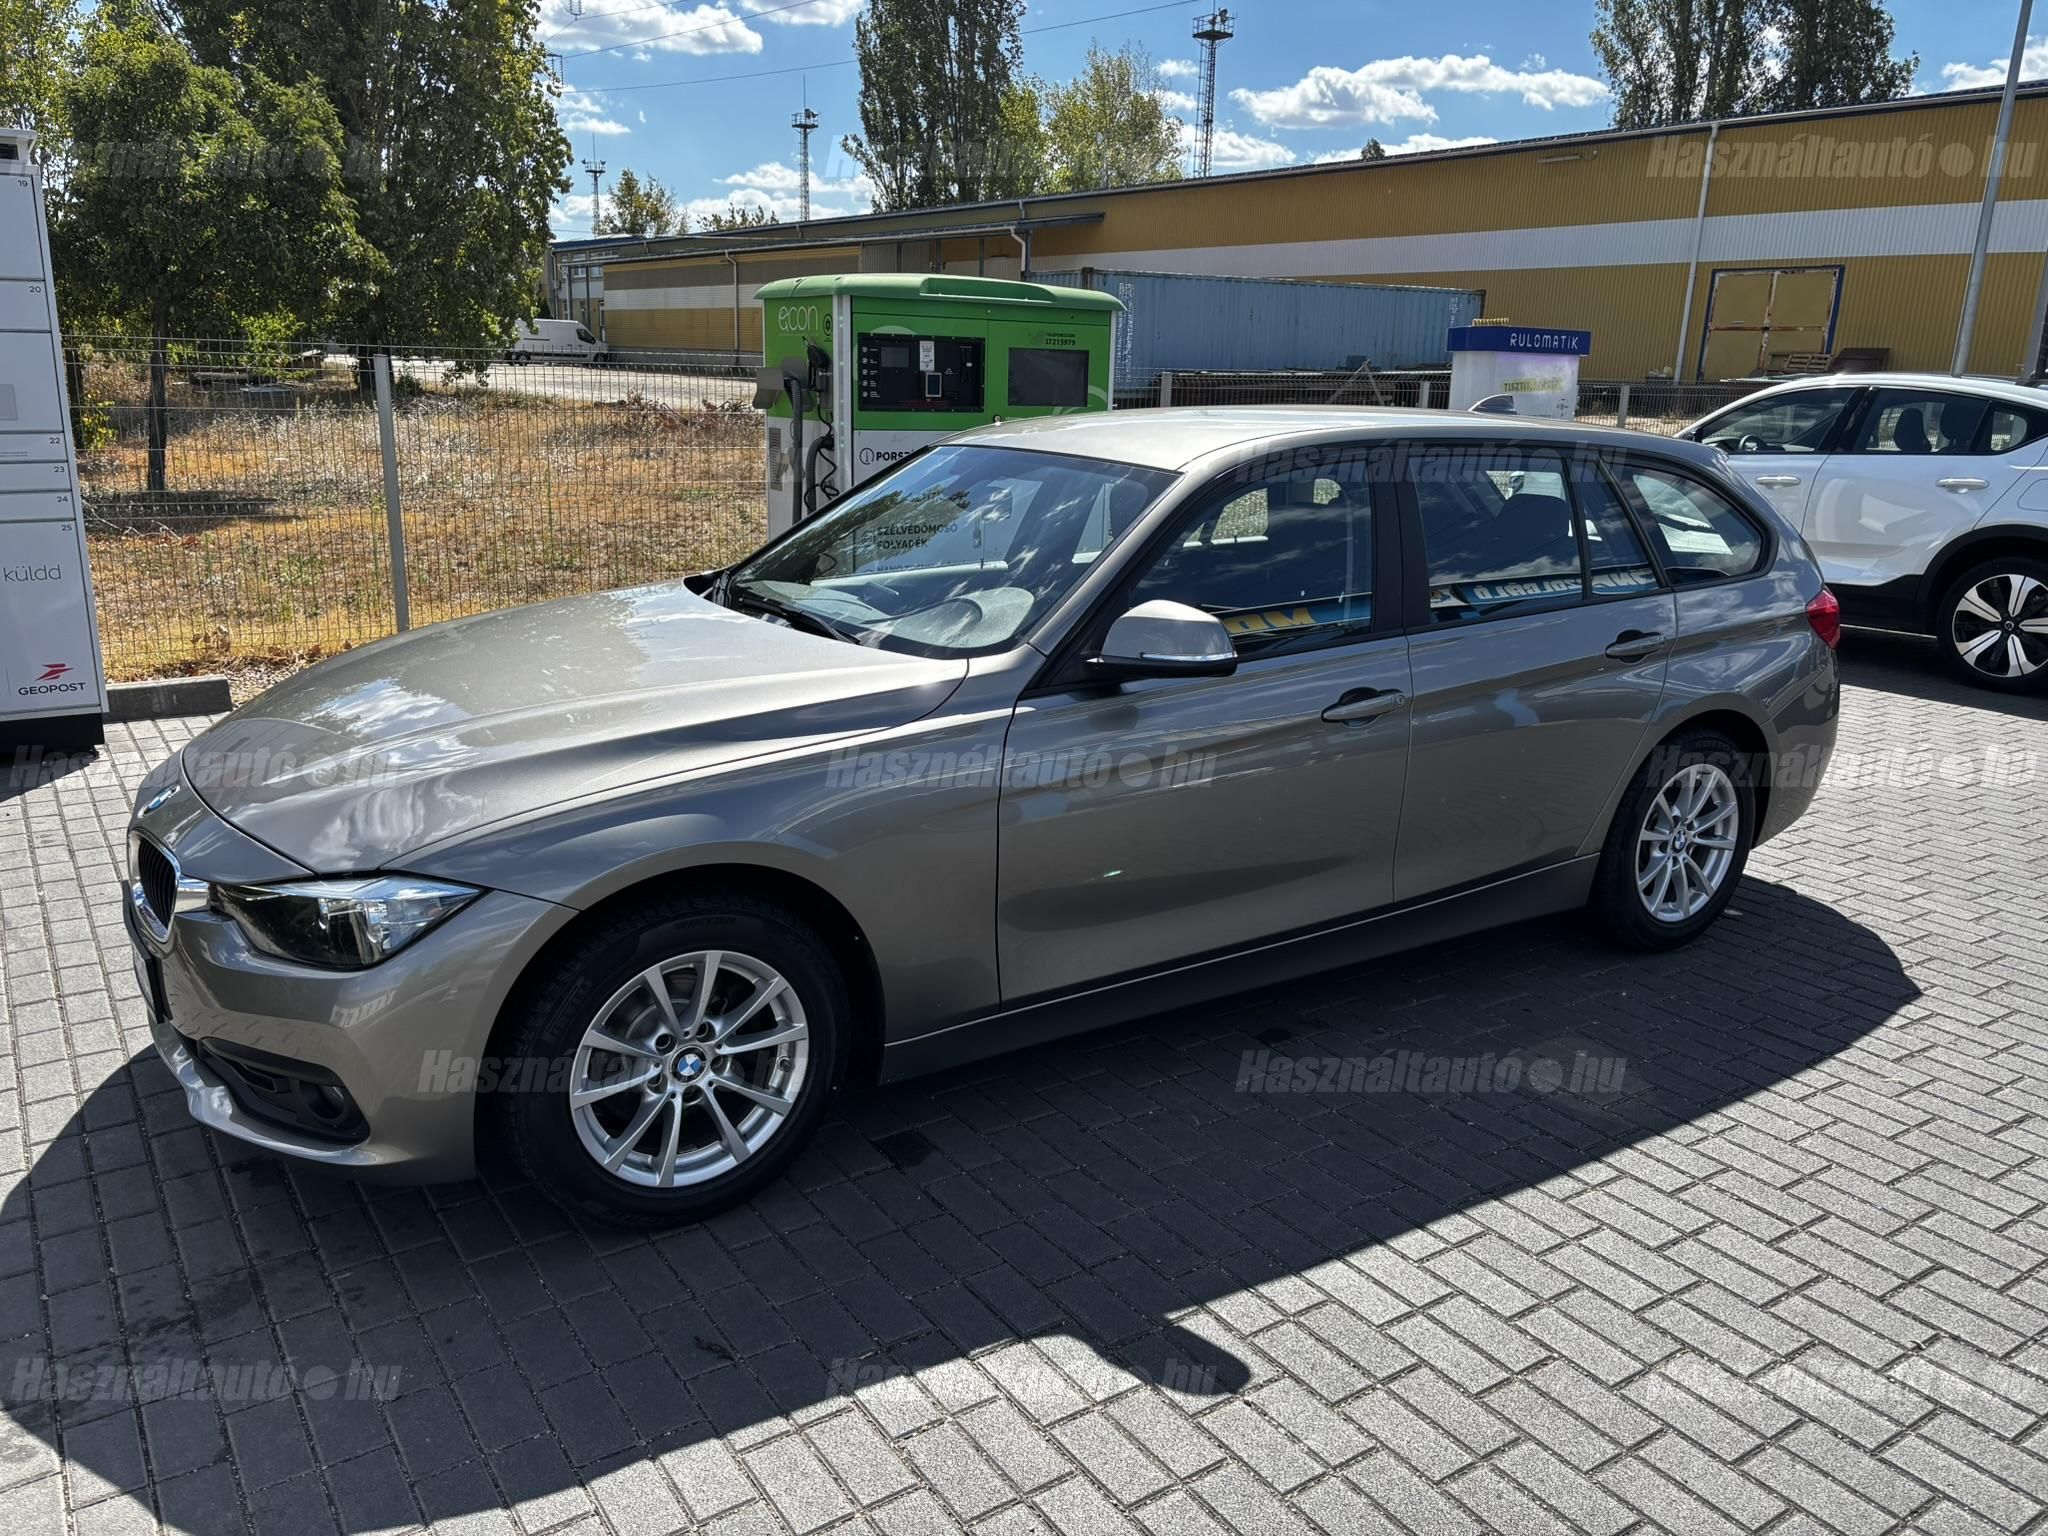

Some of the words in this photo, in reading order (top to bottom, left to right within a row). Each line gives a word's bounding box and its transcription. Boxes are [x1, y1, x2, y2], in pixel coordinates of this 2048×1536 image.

[29, 285, 42, 293] 20
[778, 305, 819, 332] econ
[1510, 332, 1579, 350] RULOMATIK
[49, 437, 61, 445] 22
[61, 524, 73, 532] 25
[3, 564, 62, 583] küldd
[18, 682, 86, 696] GEOPOST
